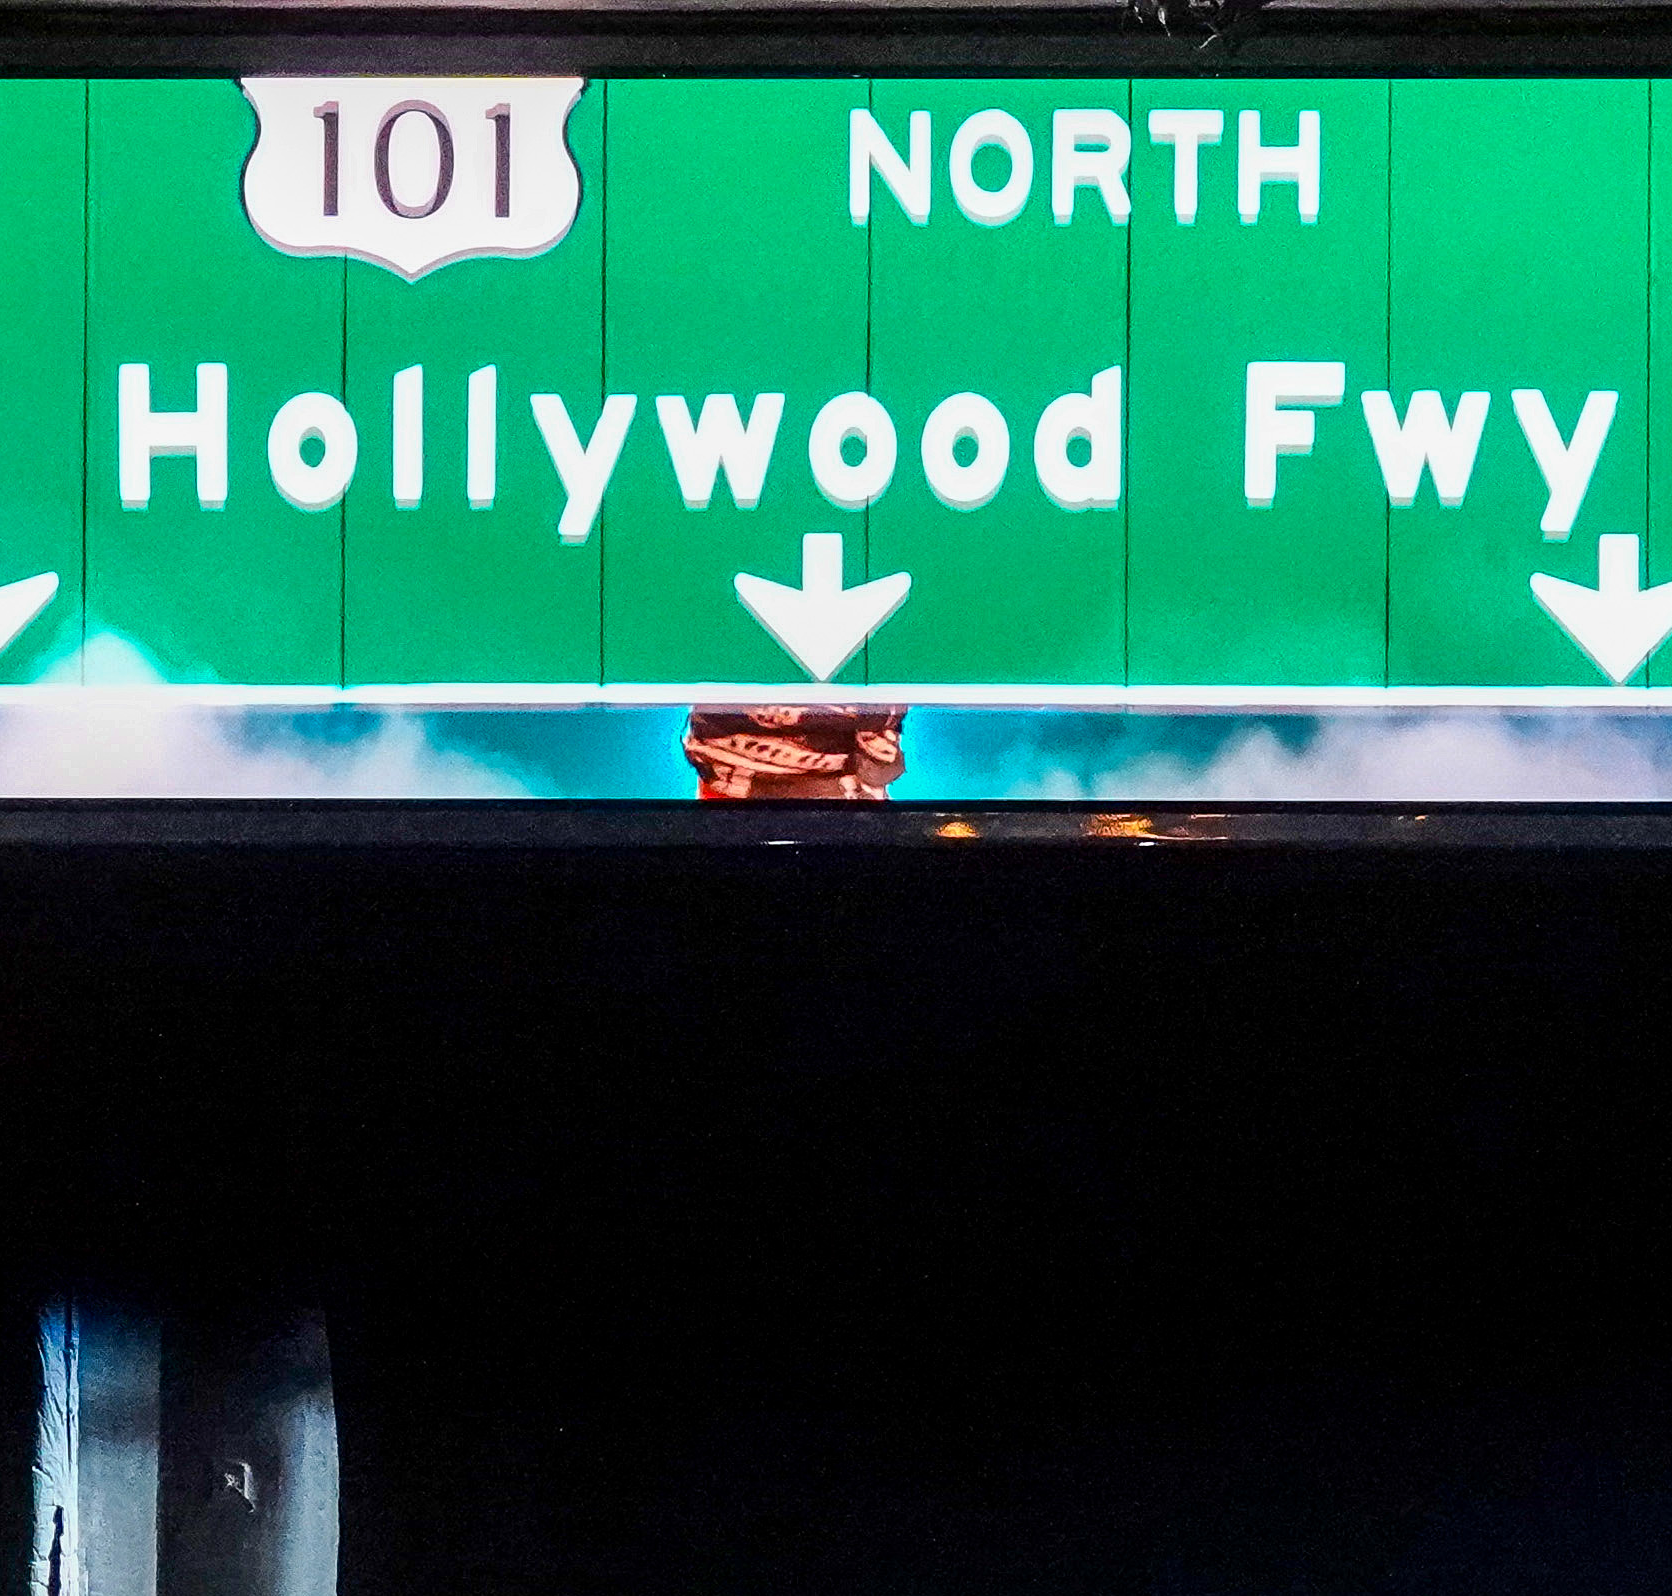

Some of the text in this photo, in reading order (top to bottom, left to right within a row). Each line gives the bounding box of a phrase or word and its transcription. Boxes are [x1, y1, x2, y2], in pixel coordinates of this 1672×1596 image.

[315, 98, 513, 220] 101
[849, 107, 1321, 226] NORTH
[117, 360, 1620, 544] Hollywood Fwy
